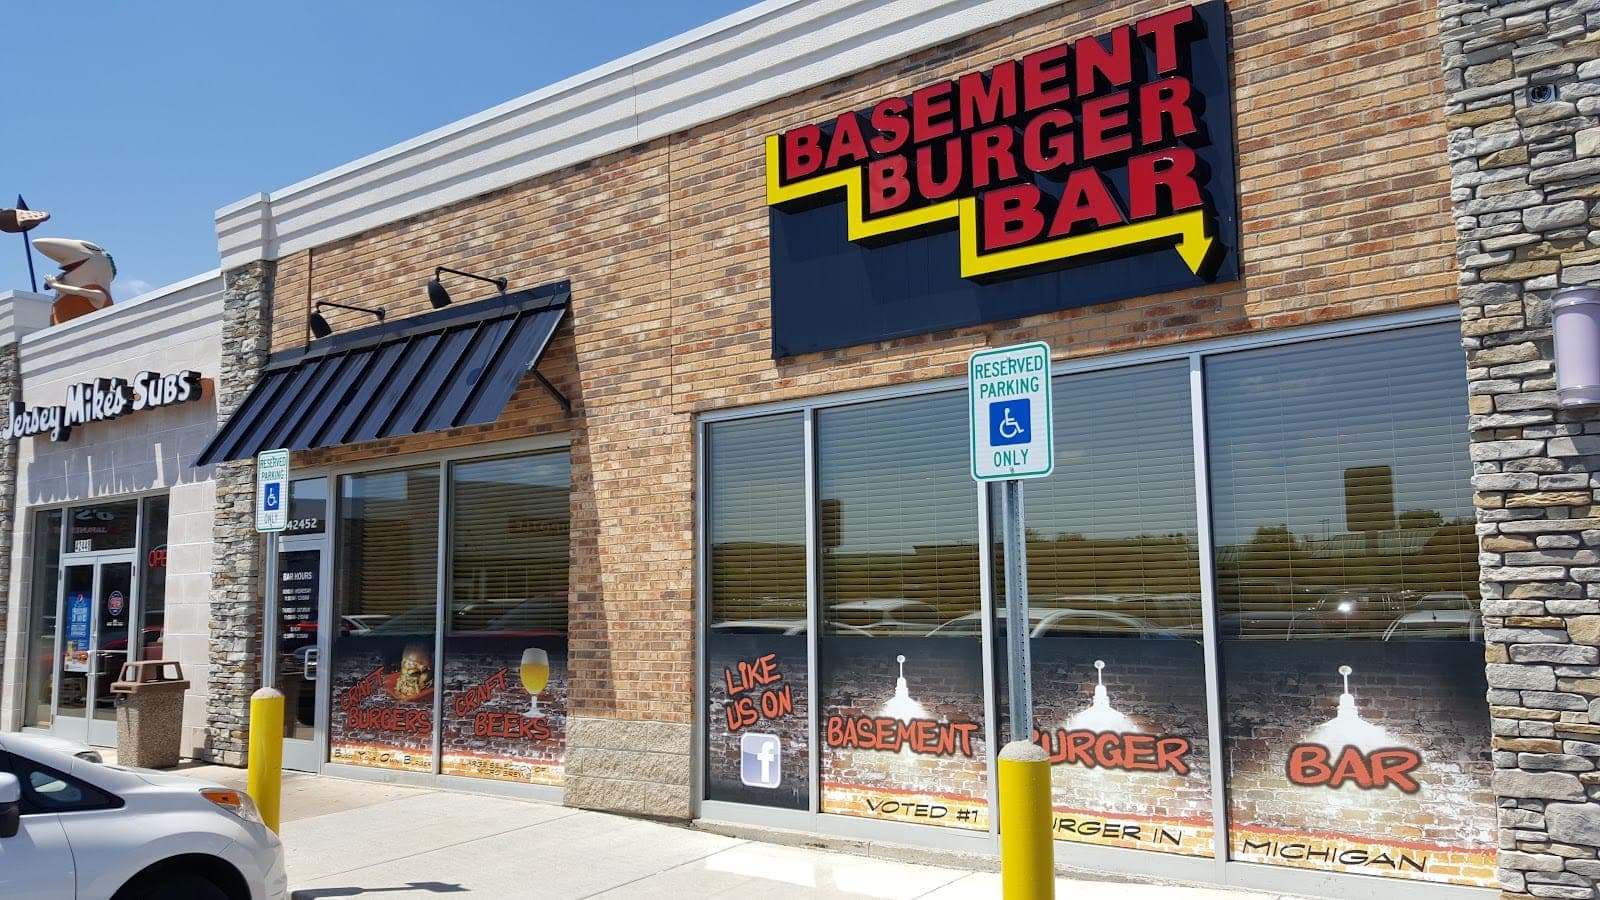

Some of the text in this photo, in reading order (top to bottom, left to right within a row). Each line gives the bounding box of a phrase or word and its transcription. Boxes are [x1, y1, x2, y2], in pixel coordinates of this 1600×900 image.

[785, 4, 1194, 181] BASEMENT
[868, 76, 1198, 214] BURGER
[982, 147, 1203, 250] BAR
[975, 355, 1043, 380] RESERVED
[980, 377, 1039, 399] PARKING
[2, 401, 62, 442] Jersey
[64, 378, 128, 427] Mike's
[260, 456, 286, 468] RESERVED
[993, 449, 1029, 467] ONLY
[261, 469, 284, 480] PARKING
[264, 512, 278, 524] ONLY
[287, 518, 317, 530] 42452
[148, 549, 168, 567] OPE
[294, 571, 312, 580] HOURS
[340, 666, 384, 711] CRAFT
[725, 653, 783, 696] LIKE
[455, 668, 508, 717] CRAFT
[348, 706, 432, 733] BURGERS
[726, 685, 793, 731] US ON
[474, 712, 550, 740] BEERS
[826, 716, 979, 757] BASEMENT
[1289, 745, 1420, 791] BAR
[866, 799, 979, 823] VOTED #1
[1053, 818, 1182, 846] RGER IN
[1242, 839, 1427, 873] MICHIGAN
